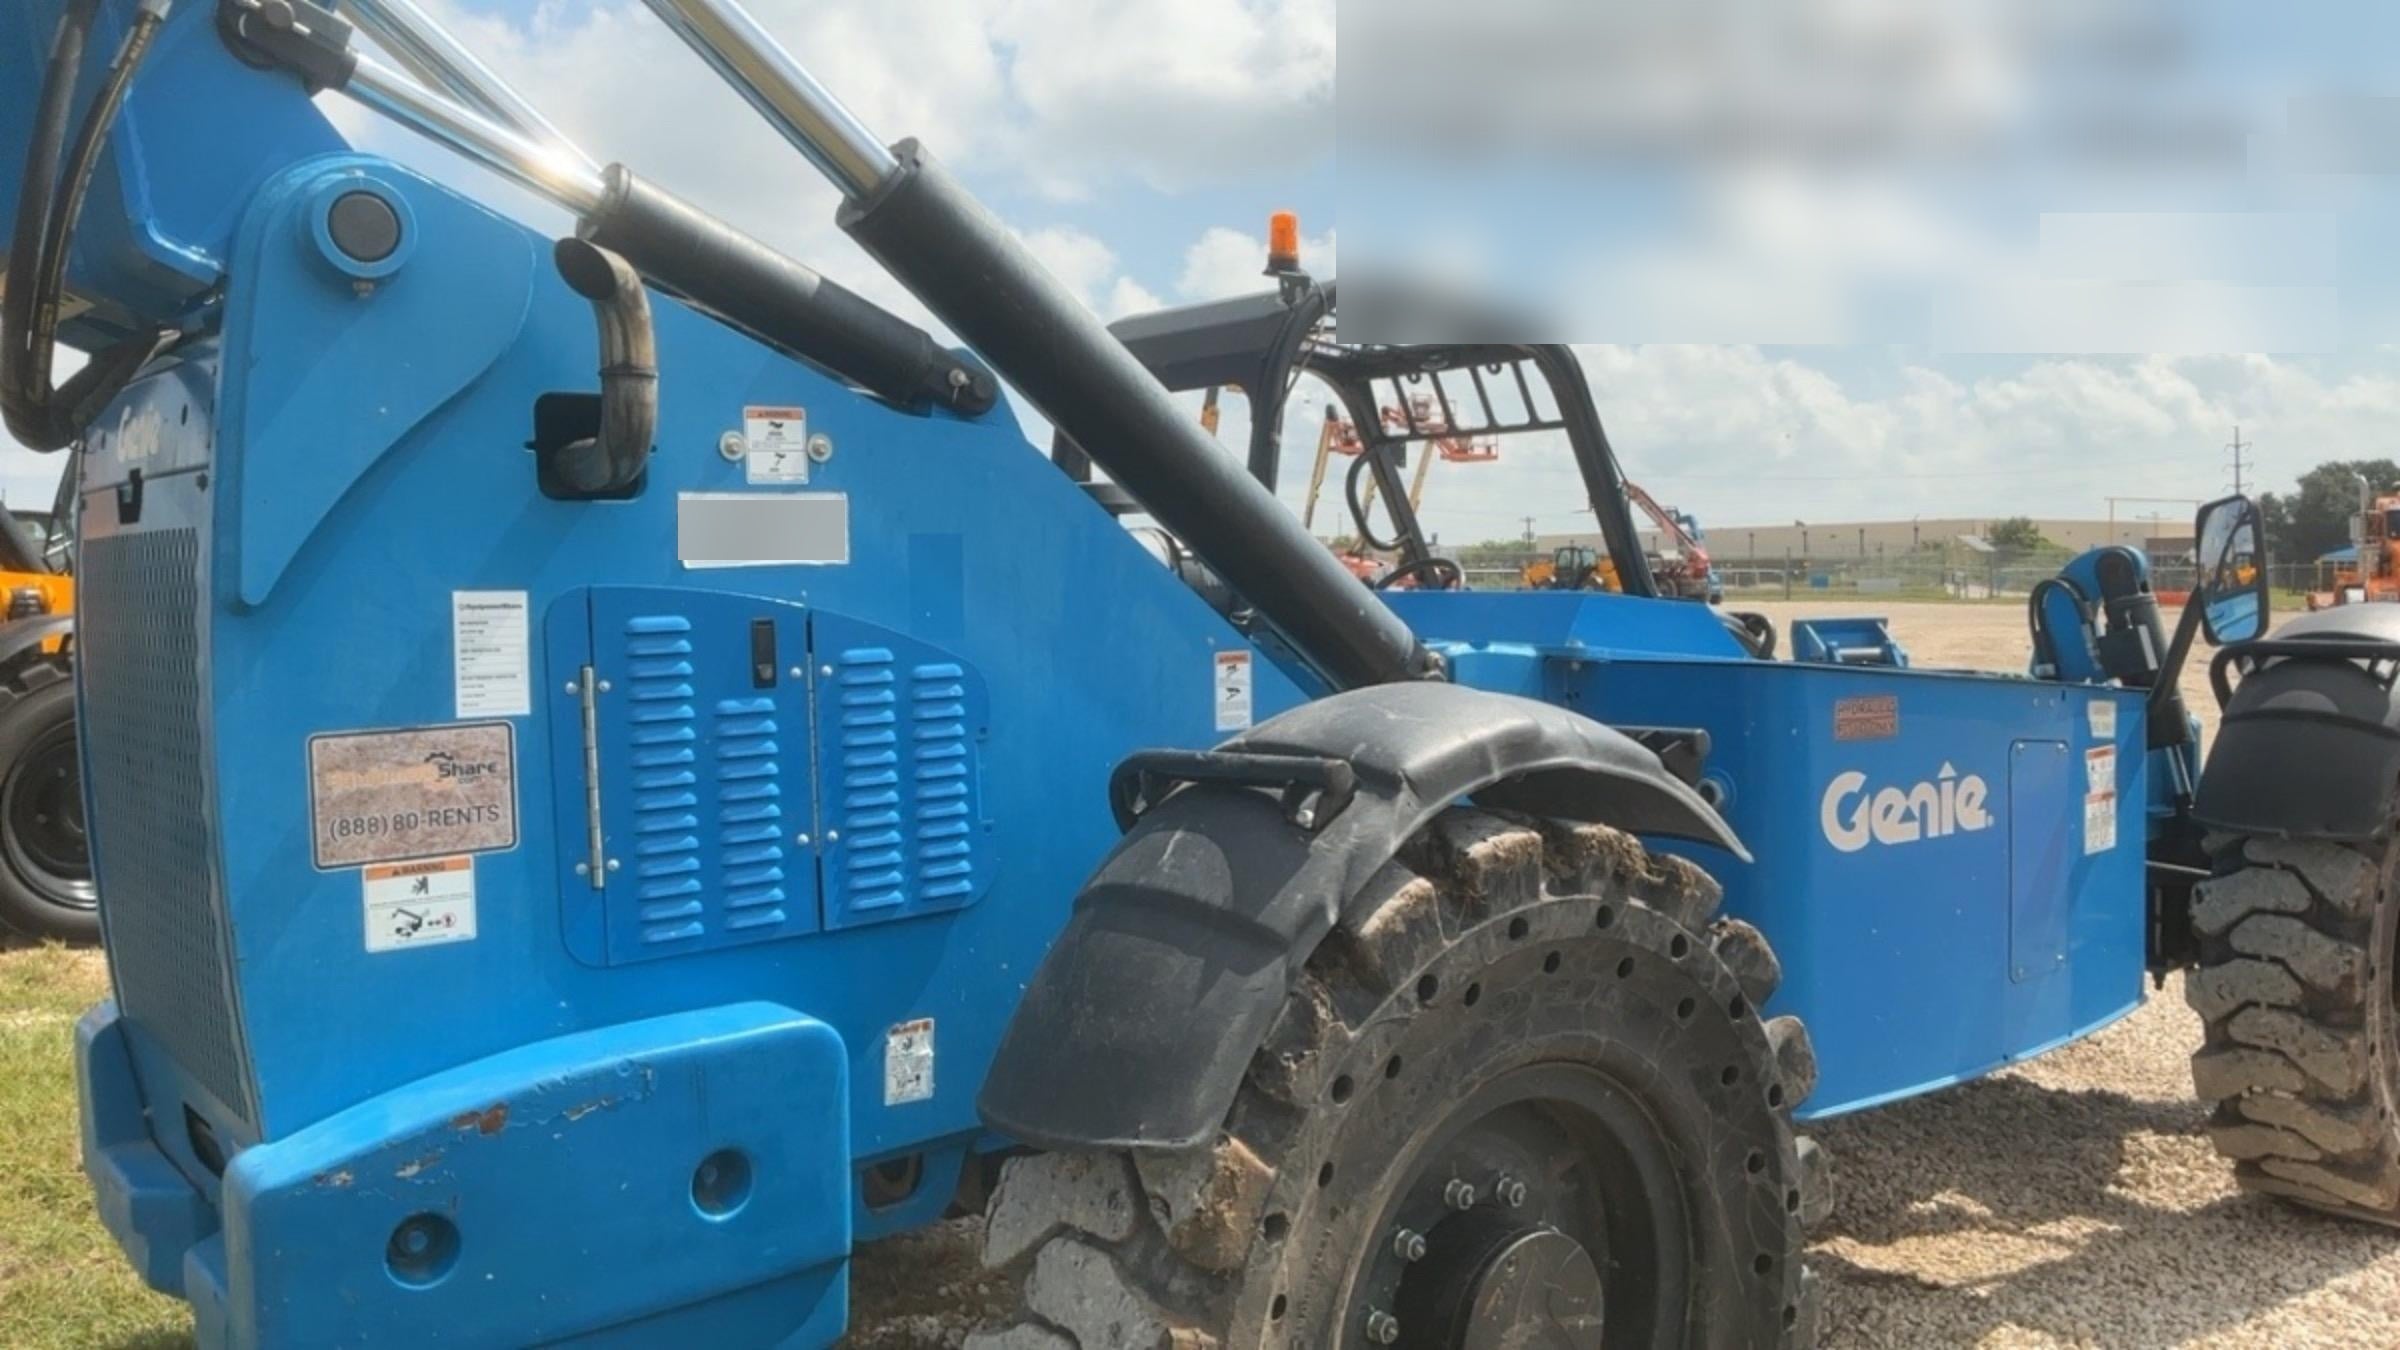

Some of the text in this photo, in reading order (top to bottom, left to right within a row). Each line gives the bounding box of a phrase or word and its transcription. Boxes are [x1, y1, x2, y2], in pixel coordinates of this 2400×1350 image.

[437, 760, 497, 779] Share
[329, 803, 500, 843] (888) 80-RENTS
[1821, 760, 1987, 852] Genie
